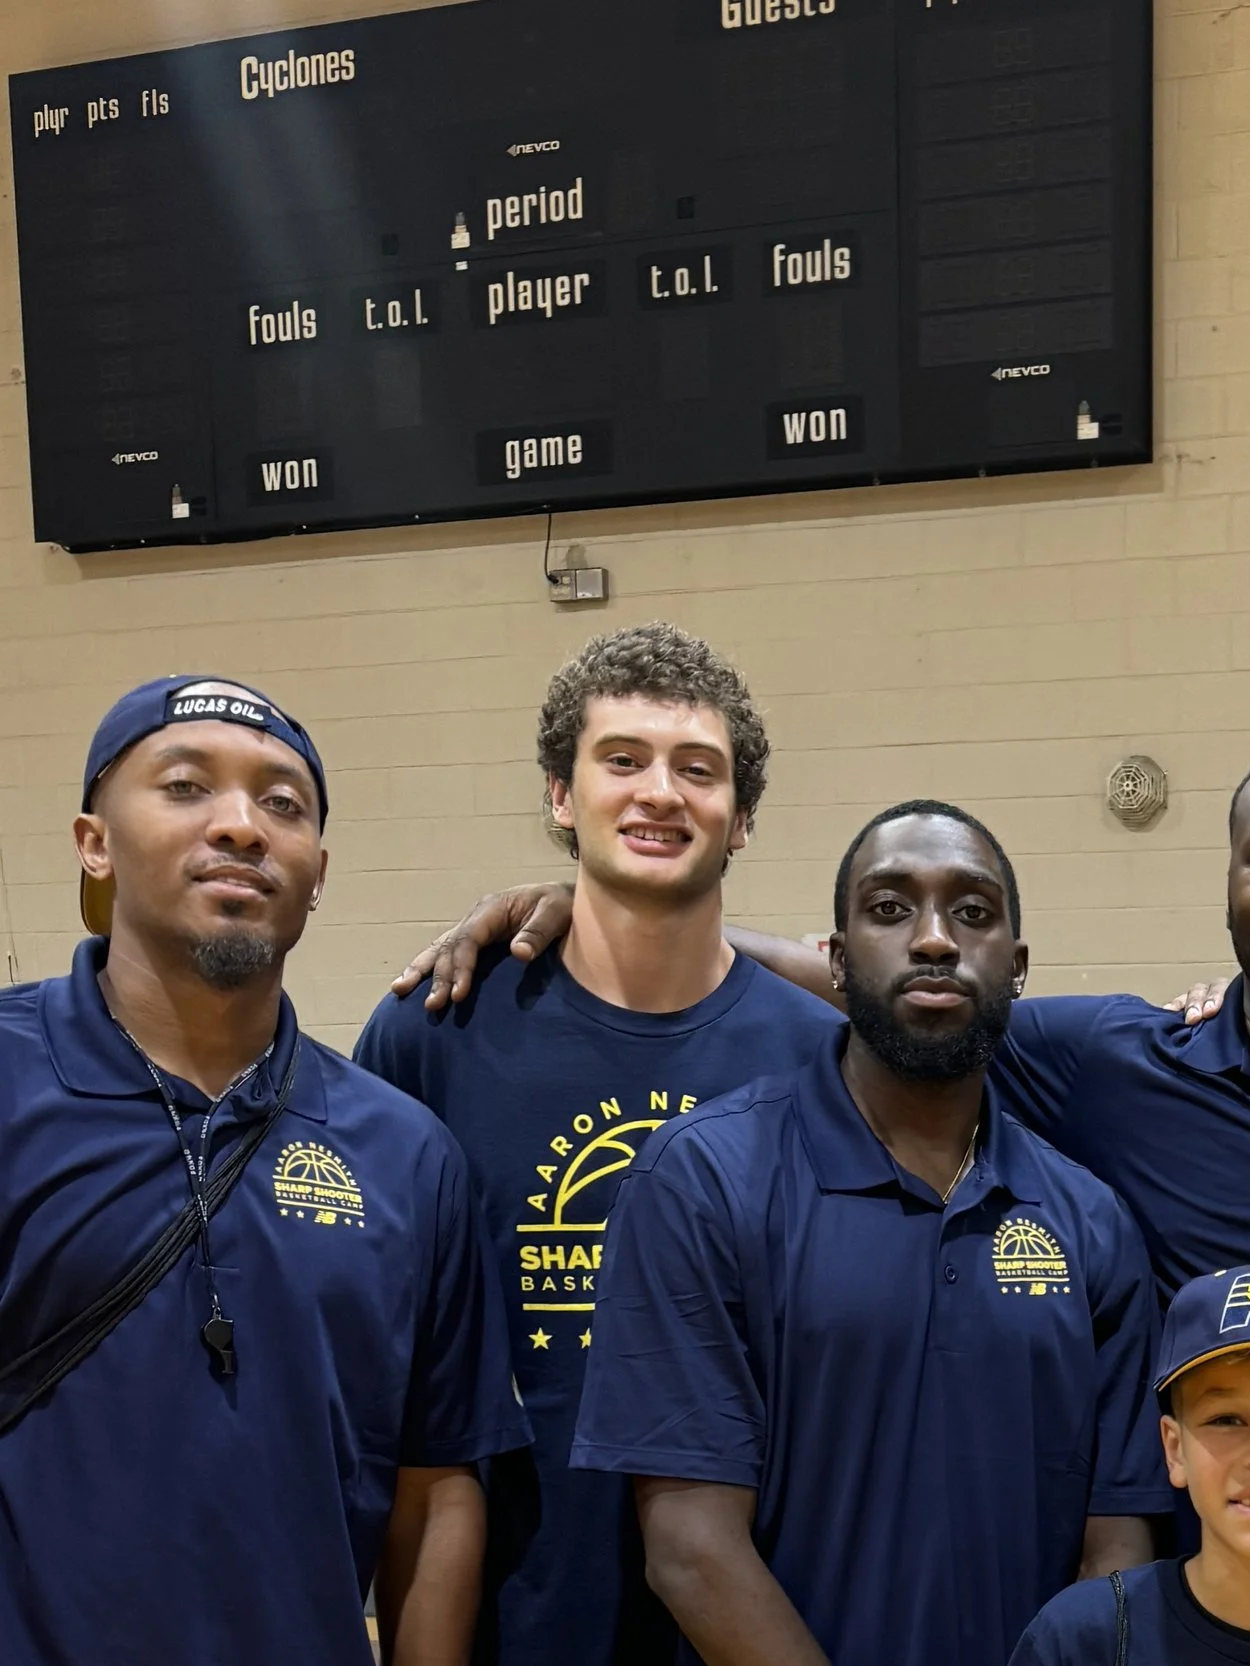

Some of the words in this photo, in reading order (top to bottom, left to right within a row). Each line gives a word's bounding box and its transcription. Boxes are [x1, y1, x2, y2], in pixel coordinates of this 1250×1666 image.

[240, 49, 355, 100] Cyclones
[33, 103, 69, 138] plyr
[87, 97, 120, 129] pts
[142, 88, 169, 117] fls
[487, 177, 583, 241] period
[773, 238, 851, 287] fouls
[488, 271, 590, 325] player
[249, 300, 317, 345] fouls
[783, 408, 847, 445] won
[261, 458, 318, 492] won
[505, 434, 582, 479] game
[174, 698, 227, 715] LUCAS
[230, 703, 263, 720] OIL
[527, 1097, 622, 1212] AARON
[274, 1181, 312, 1194] SHARP
[314, 1187, 363, 1203] SHOOTER
[994, 1261, 1025, 1270] SHARP
[1026, 1261, 1067, 1269] SHOOTER
